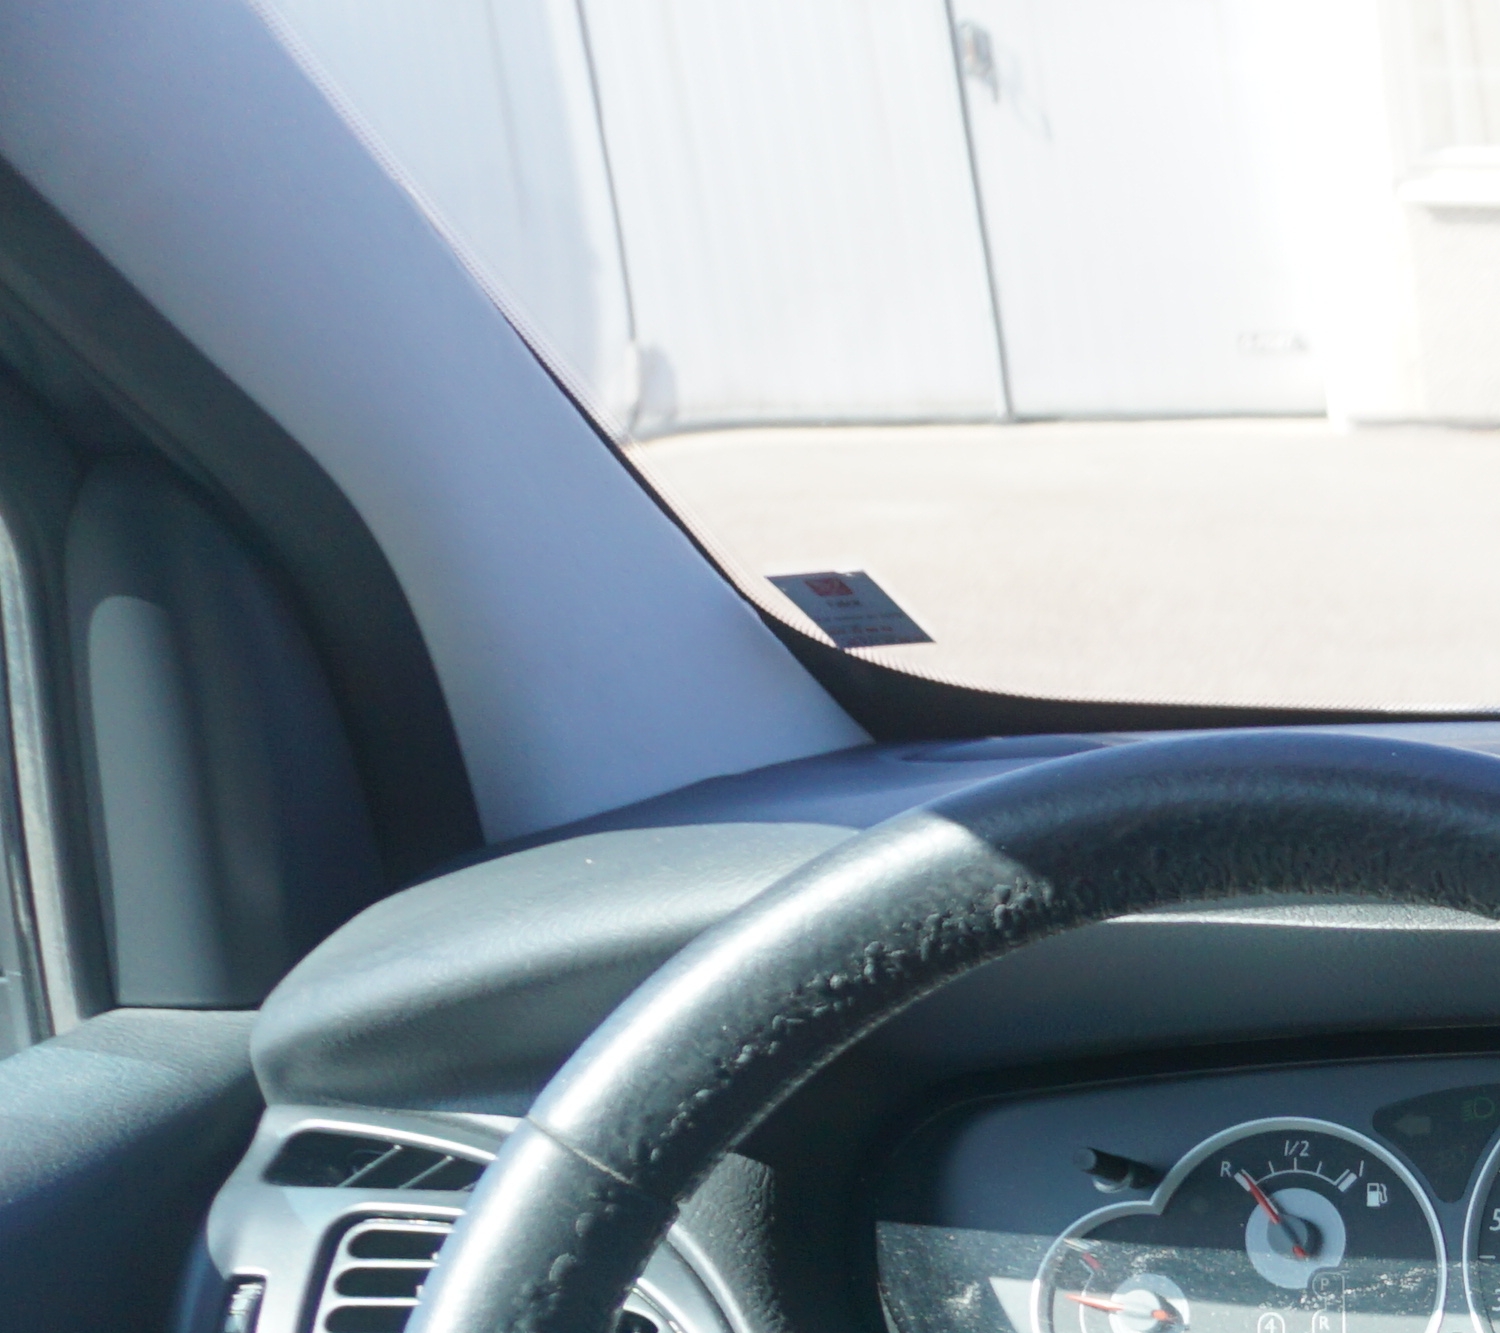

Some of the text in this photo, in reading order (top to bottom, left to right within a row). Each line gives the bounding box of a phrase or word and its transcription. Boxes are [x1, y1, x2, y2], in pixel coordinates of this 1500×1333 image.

[1284, 1140, 1310, 1157] 1/2
[1220, 1161, 1232, 1177] R
[1319, 1316, 1329, 1331] R
